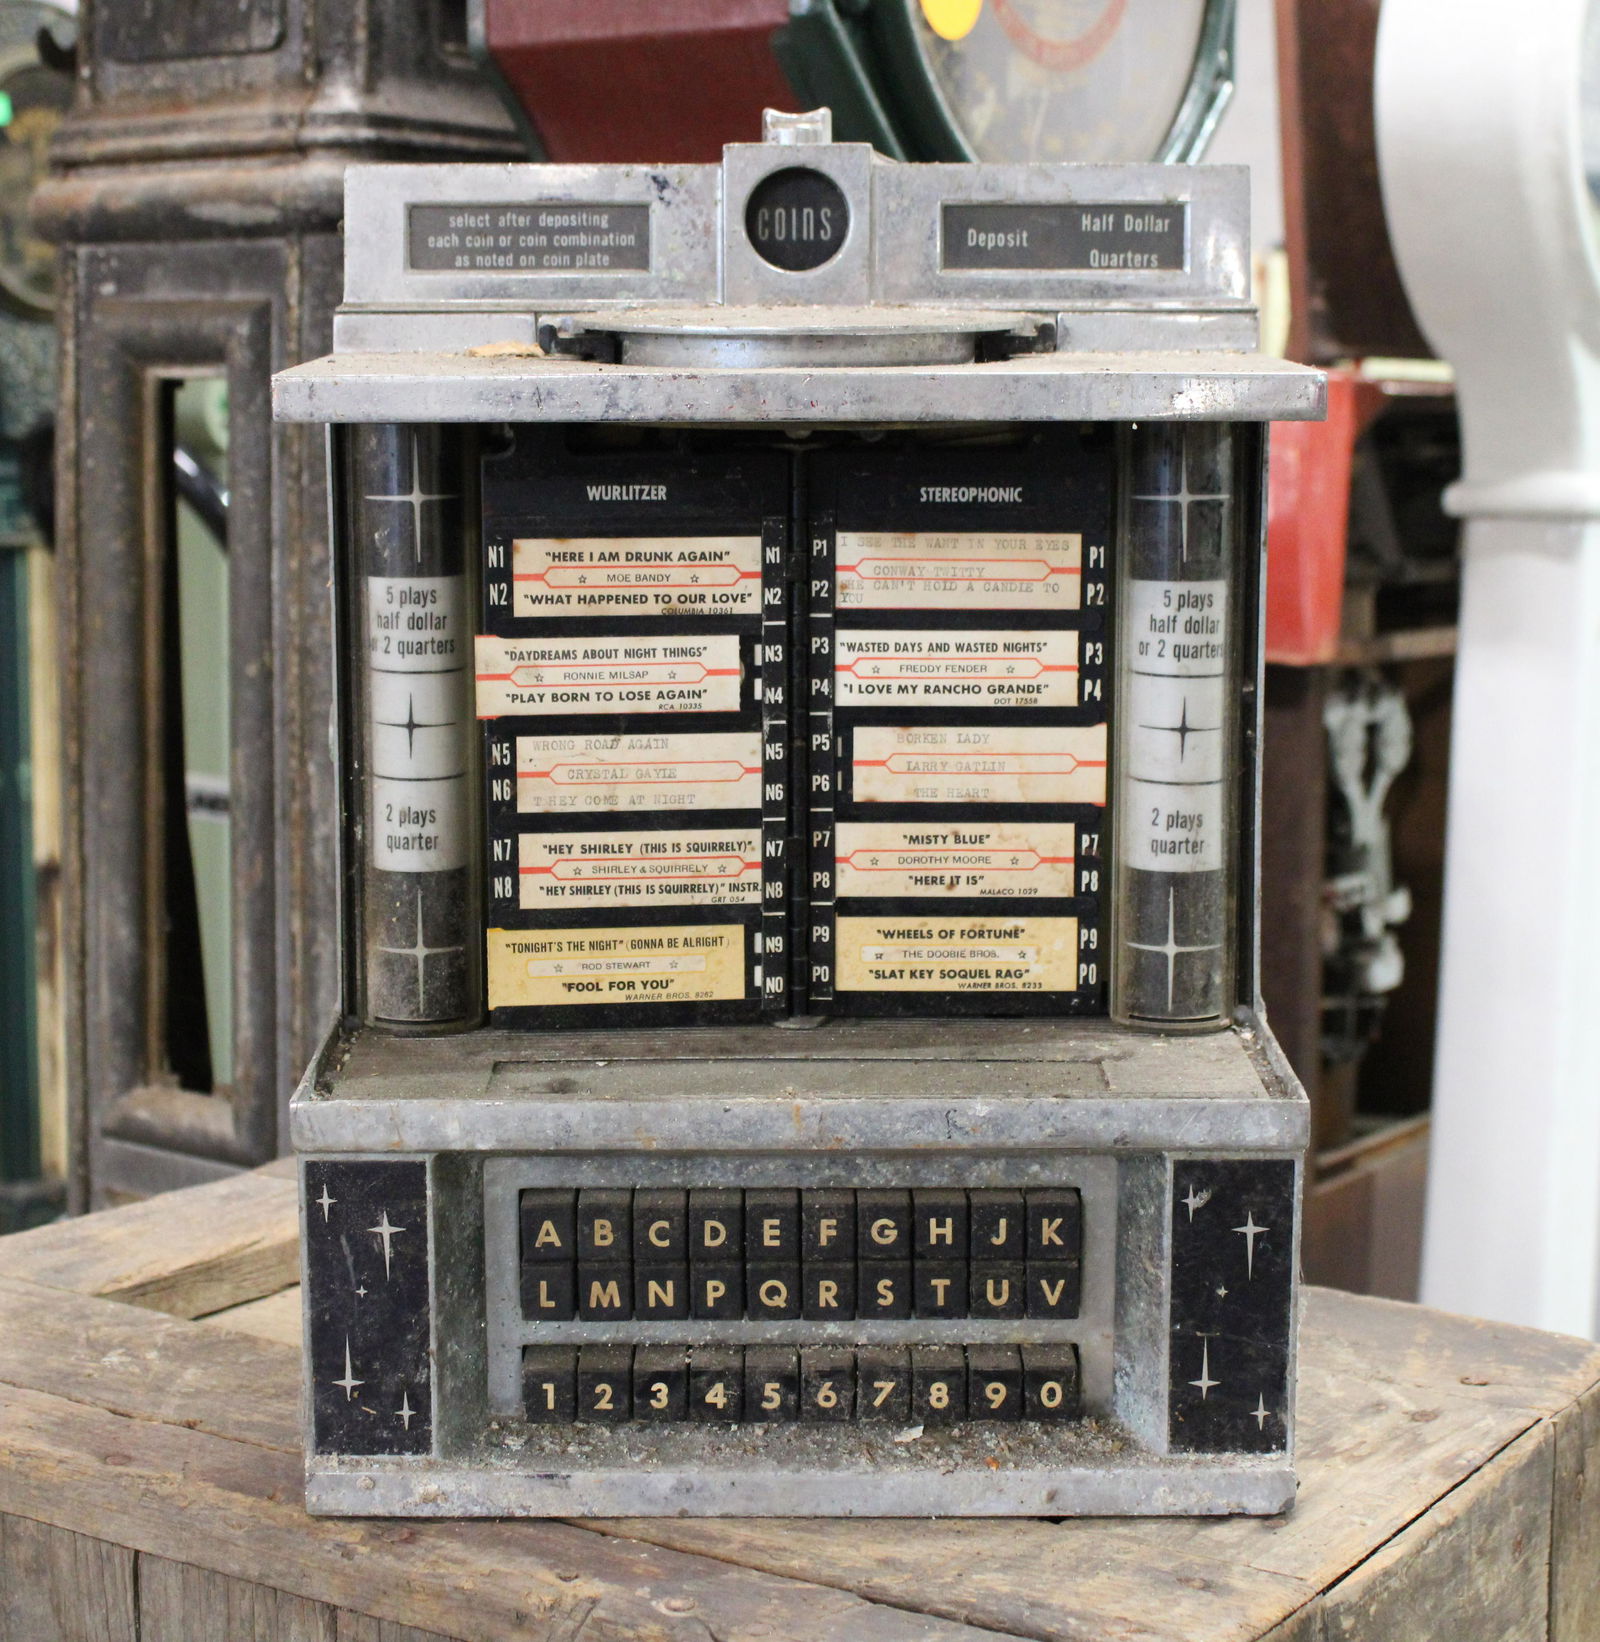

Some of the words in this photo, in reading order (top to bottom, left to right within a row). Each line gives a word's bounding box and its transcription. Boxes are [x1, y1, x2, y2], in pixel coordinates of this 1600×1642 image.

[450, 214, 490, 227] select
[499, 213, 530, 227] after
[539, 213, 608, 228] depositing
[758, 207, 833, 241] COINS
[1082, 214, 1113, 233] Half
[1124, 215, 1170, 233] Dollar
[428, 234, 458, 248] each
[466, 234, 493, 247] coin
[499, 235, 512, 247] or
[519, 234, 546, 247] coin
[554, 233, 635, 247] combination
[967, 229, 1028, 250] Deposit
[455, 255, 469, 267] as
[476, 254, 513, 267] noted
[520, 255, 535, 266] on
[543, 254, 570, 266] coin
[576, 254, 609, 268] plate
[1089, 250, 1158, 269] Quarters
[587, 485, 667, 500] WURLITZER
[920, 487, 1022, 502] STEREOPHONIC
[766, 548, 780, 564] N1
[813, 539, 827, 557] P1
[489, 546, 504, 568] N1
[590, 552, 593, 562] I
[597, 552, 620, 562] AM
[625, 551, 674, 562] DRUNK
[1090, 546, 1105, 568] P1
[607, 574, 632, 583] MOE
[635, 573, 671, 583] BANDY
[490, 583, 507, 606] N2
[765, 588, 782, 605] N2
[812, 580, 828, 597] P2
[1087, 583, 1104, 606] P2
[387, 587, 393, 604] 5
[400, 587, 437, 608] plays
[577, 593, 648, 605] HAPPENED
[653, 594, 672, 604] TO
[677, 593, 706, 604] OUR
[1164, 590, 1171, 608] 5
[1178, 590, 1214, 612] plays
[408, 613, 447, 630] dollar
[1150, 614, 1176, 634] half
[1184, 616, 1219, 634] dollar
[384, 637, 391, 654] 2
[398, 637, 455, 658] quarters
[582, 649, 620, 660] ABOUT
[624, 648, 658, 659] NIGHT
[765, 645, 783, 662] N3
[895, 642, 922, 653] DAYS
[927, 642, 950, 652] AND
[955, 642, 998, 652] WASTED
[1139, 641, 1150, 656] or
[1158, 640, 1165, 658] 2
[564, 672, 605, 680] RONNIE
[609, 671, 648, 680] MILSAP
[900, 664, 941, 673] FREDDY
[945, 664, 987, 673] FENDER
[551, 692, 591, 702] BORN
[595, 692, 613, 701] TO
[619, 691, 651, 701] LOSE
[859, 684, 892, 694] LOVE
[897, 684, 919, 694] MY
[924, 684, 982, 694] RANCHO
[766, 743, 783, 760] N5
[386, 804, 392, 822] 2
[399, 804, 436, 827] plays
[1152, 808, 1159, 826] 2
[1166, 810, 1203, 832] plays
[387, 833, 439, 852] quarter
[581, 844, 633, 854] SHIRLEY
[639, 843, 667, 855] (THIS
[673, 842, 681, 853] IS
[766, 840, 783, 857] N7
[1151, 837, 1204, 855] quarter
[898, 855, 949, 864] DOROTHY
[953, 855, 991, 864] MOORE
[592, 865, 637, 874] SHIRLEY
[649, 863, 708, 873] SQUIRRELY
[950, 876, 961, 886] IT
[570, 885, 611, 895] SHIRLEY
[614, 885, 641, 896] (THIS
[646, 885, 655, 894] IS
[938, 929, 956, 939] OF
[566, 941, 585, 952] THE
[667, 938, 678, 949] BE
[903, 950, 924, 958] THE
[927, 949, 966, 958] DOOBIE
[582, 962, 603, 970] ROD
[606, 961, 650, 970] STEWART
[910, 969, 934, 979] KEY
[939, 969, 990, 980] SOQUEL
[608, 981, 636, 991] FOR
[625, 993, 662, 1001] WARNER
[536, 1221, 562, 1248] A
[595, 1221, 613, 1246] B
[648, 1221, 670, 1247] C
[704, 1221, 726, 1246] D
[763, 1220, 780, 1246] E
[820, 1220, 837, 1245] F
[871, 1219, 898, 1245] G
[930, 1219, 952, 1245] H
[990, 1219, 1006, 1245] J
[1043, 1219, 1064, 1245] K
[539, 1282, 555, 1307] L
[589, 1282, 621, 1307] M
[649, 1281, 673, 1307] N
[707, 1281, 726, 1307] P
[759, 1281, 788, 1308] Q
[820, 1281, 838, 1306] R
[877, 1280, 893, 1306] S
[930, 1280, 950, 1305] T
[987, 1280, 1009, 1306] U
[1041, 1280, 1064, 1306] V
[595, 1385, 613, 1409] 2
[650, 1384, 668, 1408] 3
